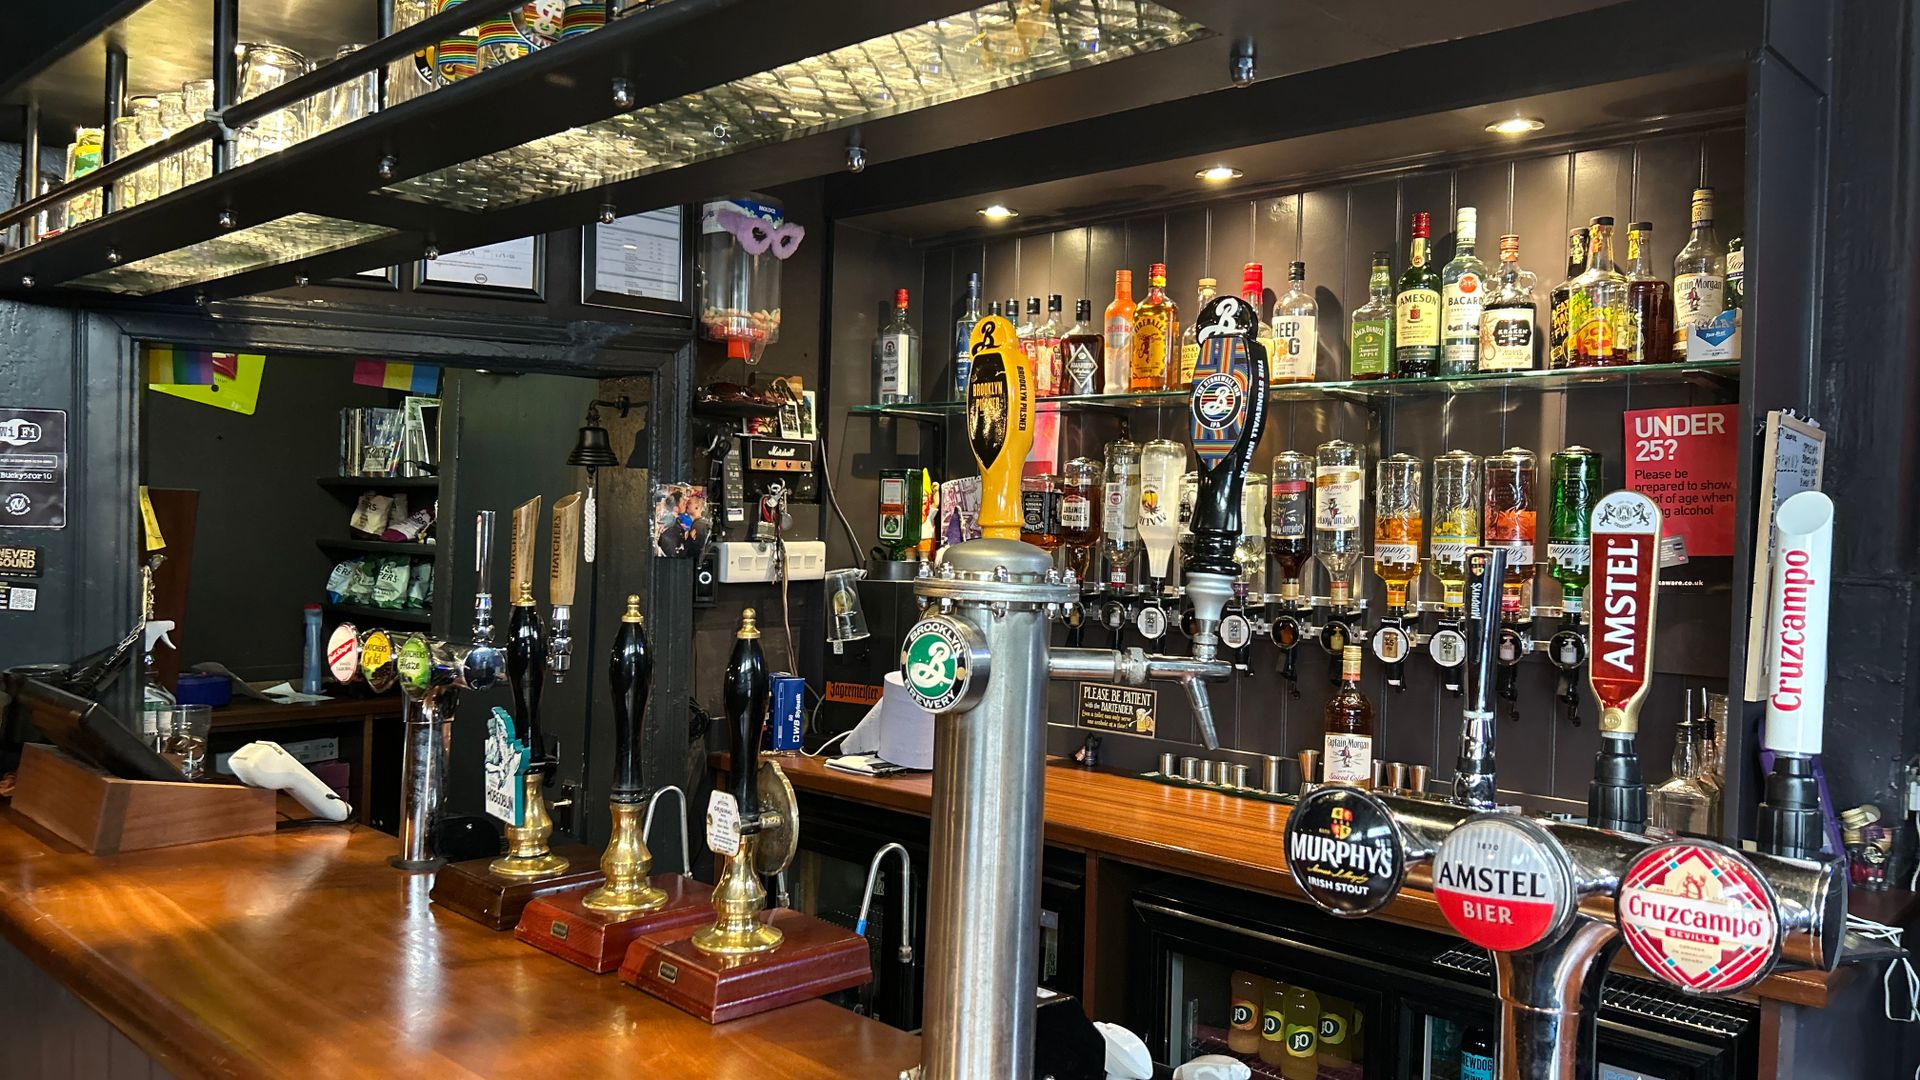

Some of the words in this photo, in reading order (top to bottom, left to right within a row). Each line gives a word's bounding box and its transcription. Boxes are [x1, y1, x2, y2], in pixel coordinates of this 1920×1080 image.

[1676, 278, 1694, 292] ptain
[1695, 276, 1722, 291] Morgan
[1398, 294, 1438, 308] JAMESON
[1448, 296, 1484, 306] BACARD
[1135, 319, 1164, 333] FIREBALL
[1353, 327, 1366, 338] JACK
[972, 381, 1003, 396] BROOKLYN
[1016, 366, 1027, 403] BROOKLYN
[1204, 375, 1234, 387] STONEWALL
[1233, 384, 1241, 397] INN
[1018, 403, 1027, 431] PILSNER
[1250, 380, 1265, 439] STONEWALL
[1634, 412, 1725, 438] UNDER
[769, 445, 796, 457] Marshall
[1245, 441, 1256, 461] INN
[1634, 439, 1679, 462] 25?
[1239, 461, 1250, 479] IPA
[1634, 469, 1672, 480] Please
[1674, 468, 1688, 479] be
[1634, 480, 1685, 494] prepared
[1687, 481, 1699, 490] to
[1700, 480, 1731, 491] show
[1665, 493, 1676, 503] of
[1678, 495, 1699, 507] age
[1701, 492, 1734, 503] when
[1673, 505, 1714, 516] alcohol
[1138, 513, 1167, 526] MALIB
[1333, 515, 1356, 526] Captain
[1282, 525, 1305, 535] Captain
[551, 514, 561, 579] THATCHERS
[1470, 582, 1482, 620] MURPHY'S
[1603, 538, 1639, 673] AMSTEL
[1771, 549, 1815, 712] Cruzcampo
[909, 623, 963, 657] BROOKLYN
[400, 659, 420, 670] Haze
[904, 678, 955, 709] BREWERY
[1083, 686, 1110, 701] PLEASE
[1111, 689, 1122, 703] BE
[1122, 691, 1152, 706] PATIENT
[1101, 702, 1134, 715] BARTENDER
[793, 719, 800, 734] WB
[1326, 736, 1346, 748] Captain
[1348, 737, 1369, 749] Morgan
[1328, 772, 1349, 782] Spiced
[1476, 841, 1500, 851] 1870
[1291, 831, 1393, 879] MURPHY'S
[1307, 875, 1334, 891] IRISH
[1334, 882, 1370, 896] STOUT
[1438, 861, 1546, 898] AMSTEL
[1462, 900, 1514, 925] BIER
[1628, 893, 1763, 938] Cruzcampo
[1669, 929, 1716, 944] SEVILLA
[1464, 1058, 1493, 1071] EWDOG
